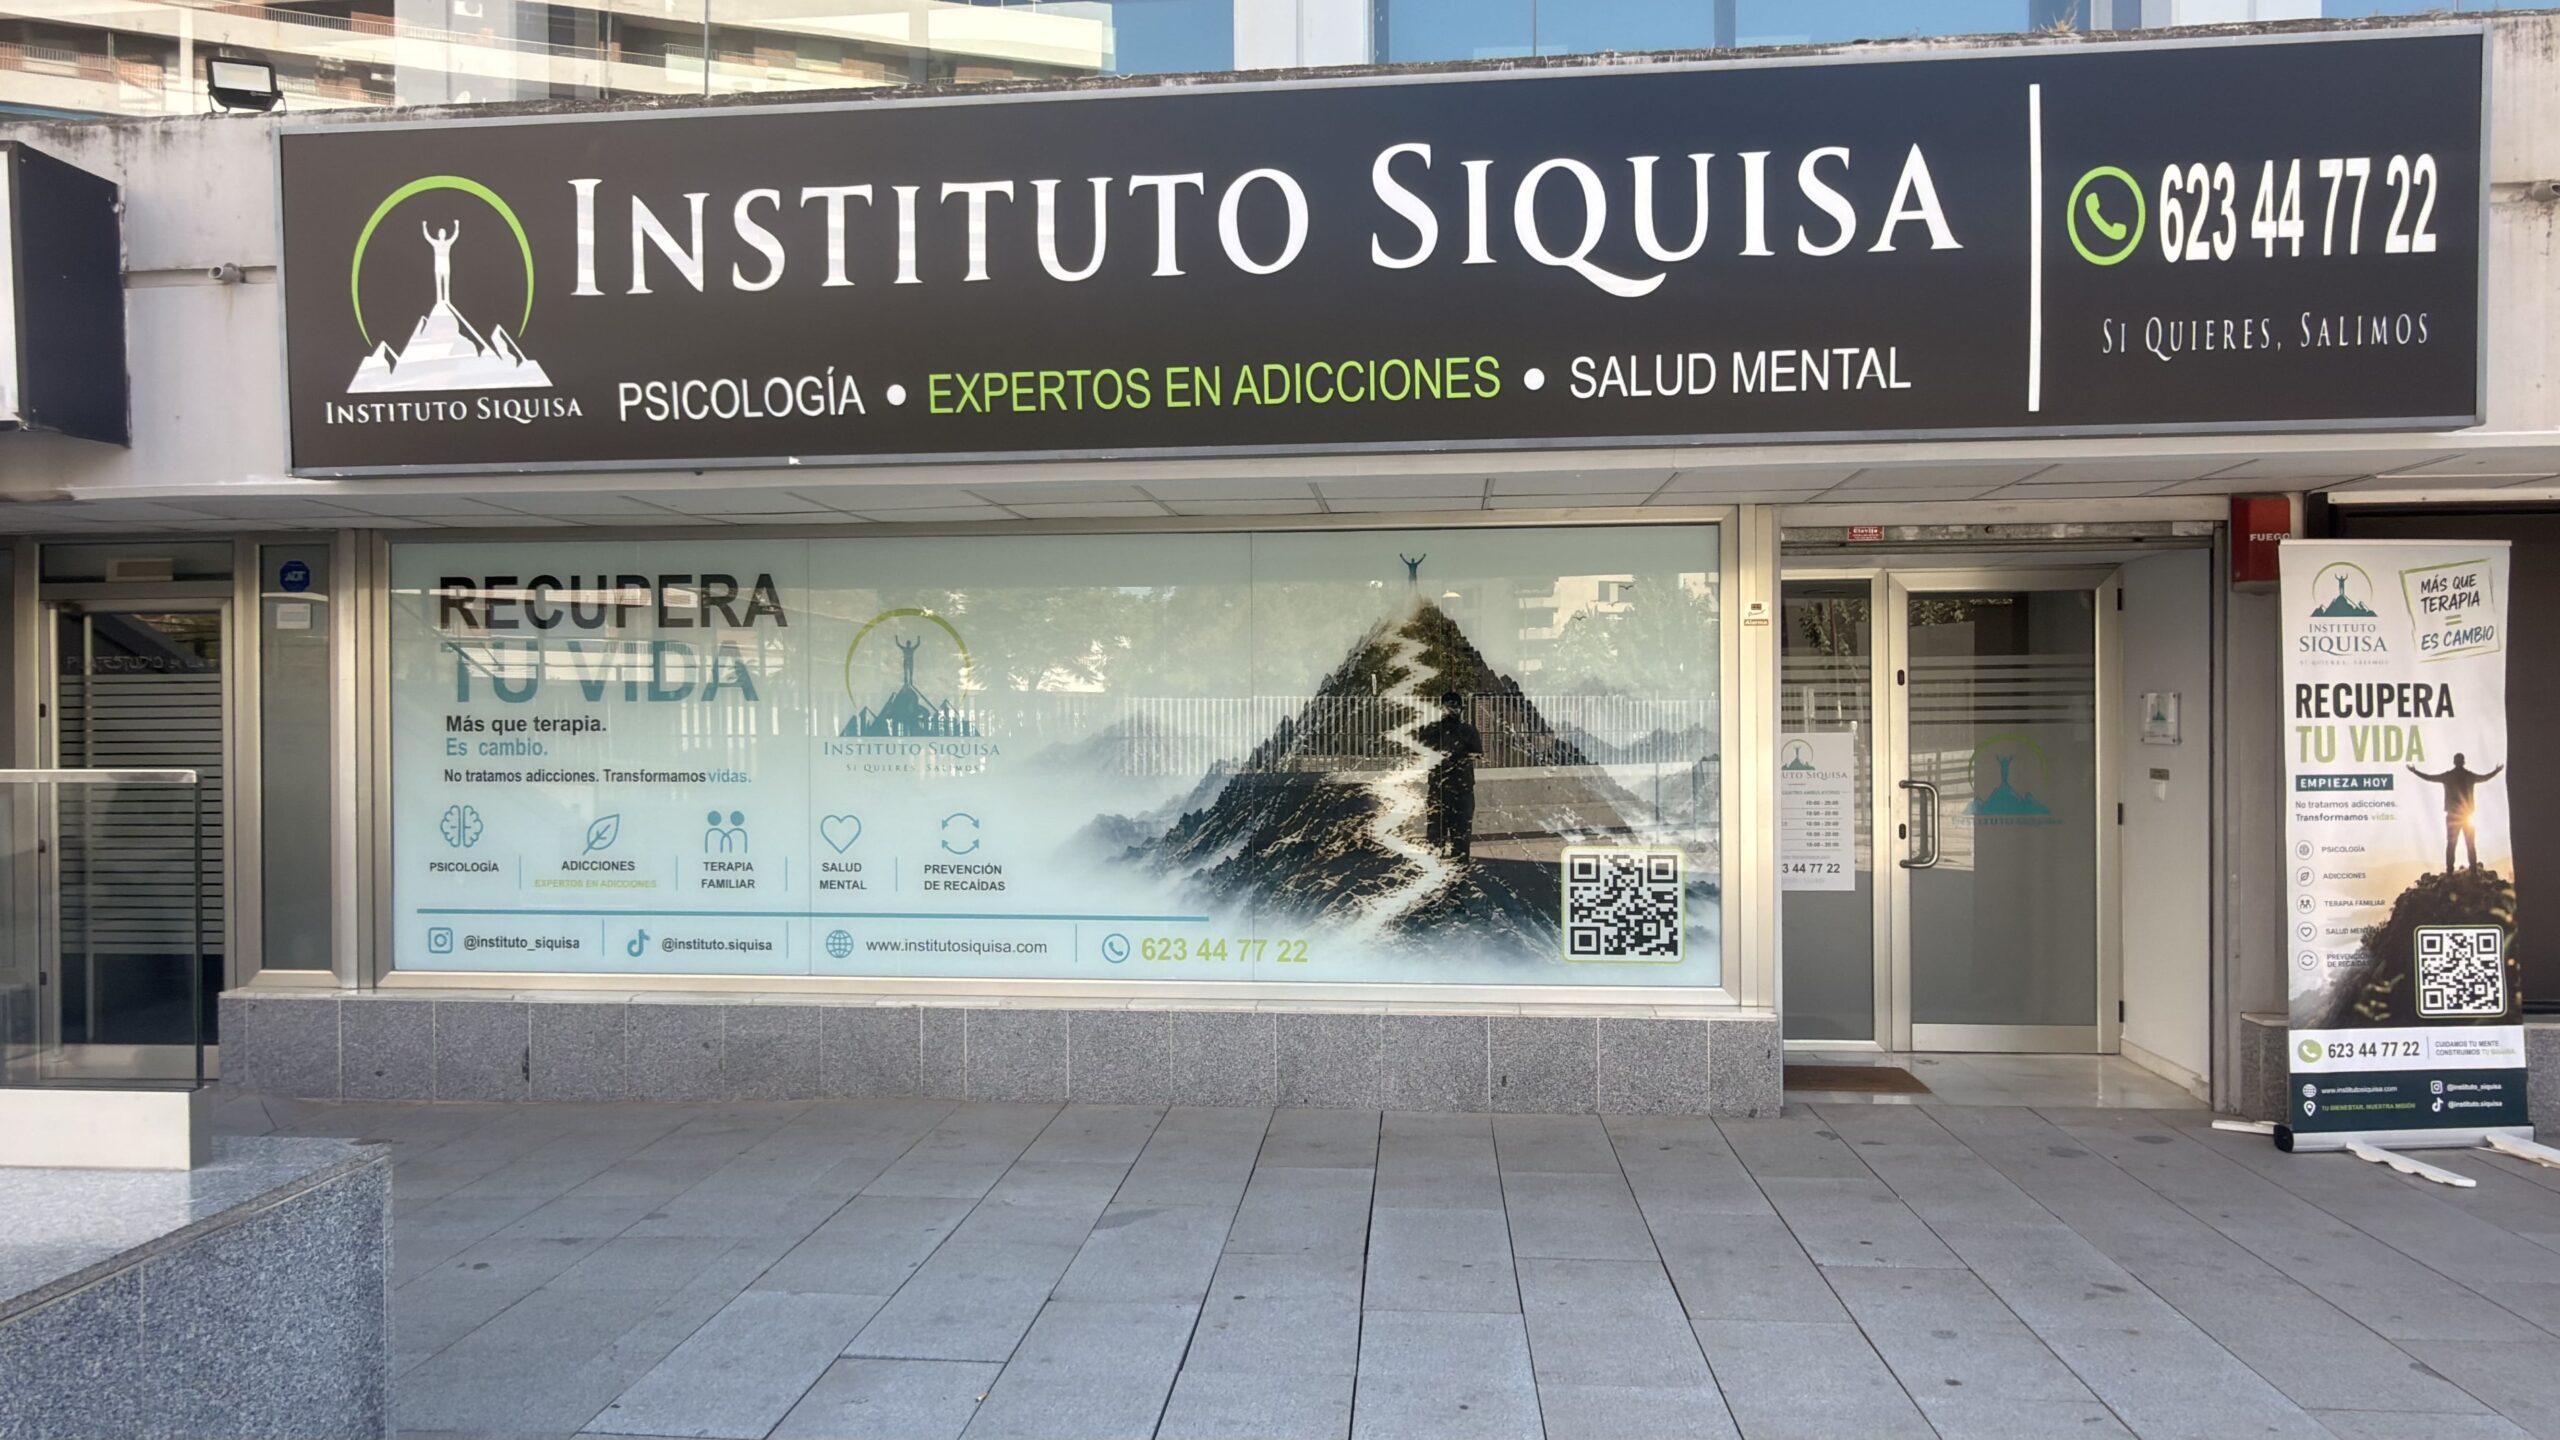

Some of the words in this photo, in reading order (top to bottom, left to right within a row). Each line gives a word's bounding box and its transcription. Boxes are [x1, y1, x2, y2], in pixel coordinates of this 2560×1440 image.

[2159, 161, 2237, 263] 623
[2251, 158, 2304, 258] 44
[2319, 157, 2370, 256] 77
[2385, 153, 2437, 253] 22
[567, 167, 1309, 296] INSTITUTO
[1370, 142, 1964, 298] SIQUISA
[2102, 317, 2127, 354] SI
[2300, 311, 2429, 348] SALIMOS
[618, 366, 865, 422] PSICOLOGÍA
[928, 366, 1151, 414] EXPERTOS
[1166, 365, 1221, 408] EN
[1233, 354, 1501, 406] ADICCIONES
[1570, 352, 1716, 399] SALUD
[1732, 346, 1911, 394] MENTAL
[326, 398, 468, 425] INSTITUTO
[476, 396, 583, 425] SIQUISA
[2249, 533, 2290, 541] FUEGO
[2420, 574, 2448, 594] MÁS
[2452, 573, 2477, 590] QUE
[439, 573, 788, 629] RECUPERA
[2420, 591, 2481, 614] TERAPIA
[2309, 623, 2376, 633] INSTITUTO
[2299, 635, 2388, 656] SIQUISA
[2421, 634, 2439, 651] ES
[2443, 625, 2495, 647] CAMBIO
[440, 639, 538, 703] TU
[566, 639, 760, 703] VIDA
[2296, 682, 2455, 718] RECUPERA
[446, 714, 485, 733] Más
[491, 718, 528, 737] que
[533, 715, 607, 737] terapia.
[446, 738, 468, 757] Es
[479, 737, 548, 757] cambio.
[824, 741, 921, 756] INSTITUTO
[928, 741, 1000, 759] SIQUISA
[2295, 725, 2336, 764] TU
[2349, 724, 2425, 763] VIDA
[444, 769, 462, 783] No
[466, 769, 522, 783] tratamos
[526, 769, 599, 783] adicciones.
[604, 769, 706, 783] Transformamos
[708, 769, 752, 783] vidas.
[1806, 771, 1848, 781] SIQUISA
[2300, 778, 2358, 788] EMPIEZA
[2363, 777, 2388, 788] HOY
[2296, 801, 2307, 809] No
[2296, 813, 2369, 822] Transformamos
[2321, 845, 2366, 853] PSICOLOGÍA
[429, 860, 499, 873] PSICOLOGÍA
[561, 861, 635, 872] ADICCIONES
[703, 862, 754, 872] TERAPIA
[821, 862, 862, 873] SALUD
[924, 862, 1002, 875] PREVENCIÓN
[1792, 863, 1806, 874] 44
[1809, 863, 1823, 874] 77
[1826, 863, 1841, 874] 22
[2323, 872, 2366, 880] ADICCIONES
[701, 879, 755, 889] FAMILIAR
[819, 880, 867, 890] MENTAL
[924, 881, 941, 891] DE
[943, 879, 1006, 891] RECAÍDAS
[2324, 899, 2354, 907] TERAPIA
[2355, 899, 2385, 907] FAMILIAR
[464, 935, 580, 952] @instituto_siquisa
[661, 938, 772, 952] @instituto.siquisa
[866, 937, 1048, 956] www.institutosiquisa.com
[1141, 937, 1188, 962] 623
[1196, 938, 1227, 962] 44
[1237, 938, 1268, 962] 77
[1277, 939, 1309, 963] 22
[2328, 1043, 2354, 1059] 623
[2358, 1043, 2377, 1057] 44
[2381, 1042, 2398, 1057] 77
[2402, 1041, 2420, 1057] 22
